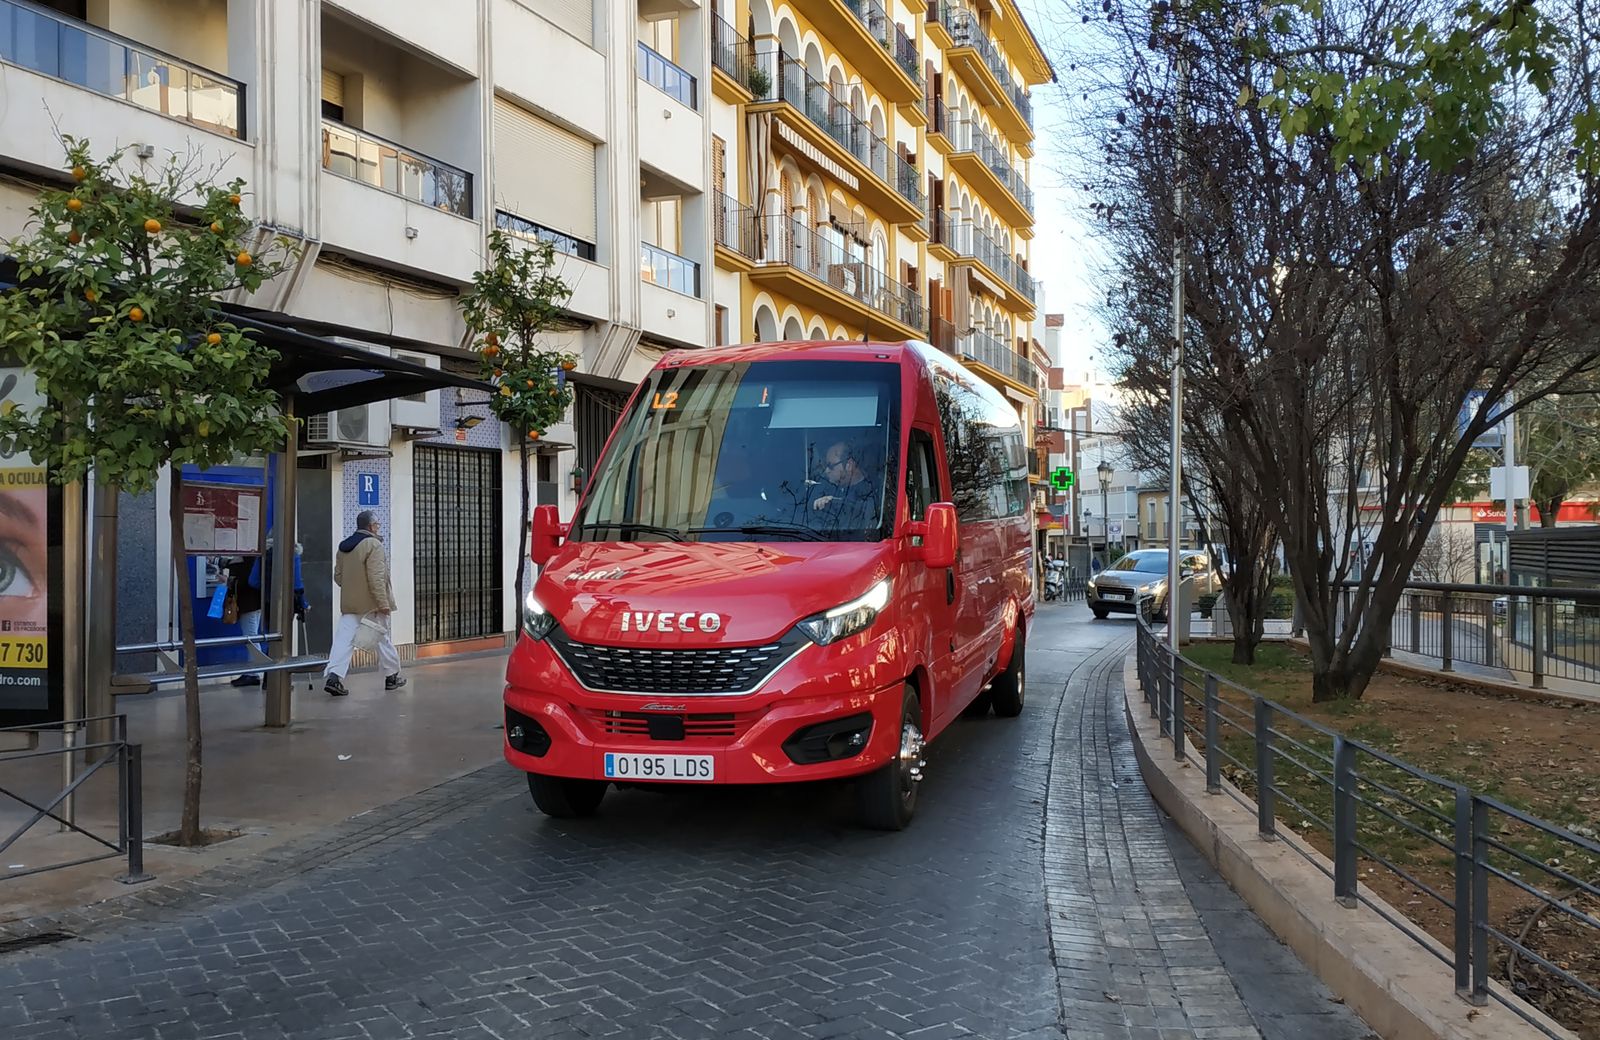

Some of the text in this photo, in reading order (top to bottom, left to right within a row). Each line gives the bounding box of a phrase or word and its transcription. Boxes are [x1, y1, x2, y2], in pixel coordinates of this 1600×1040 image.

[652, 392, 678, 408] L2
[364, 475, 374, 492] R
[621, 612, 721, 633] IVECO
[16, 643, 43, 662] 730
[618, 757, 710, 777] 0195 LDS
